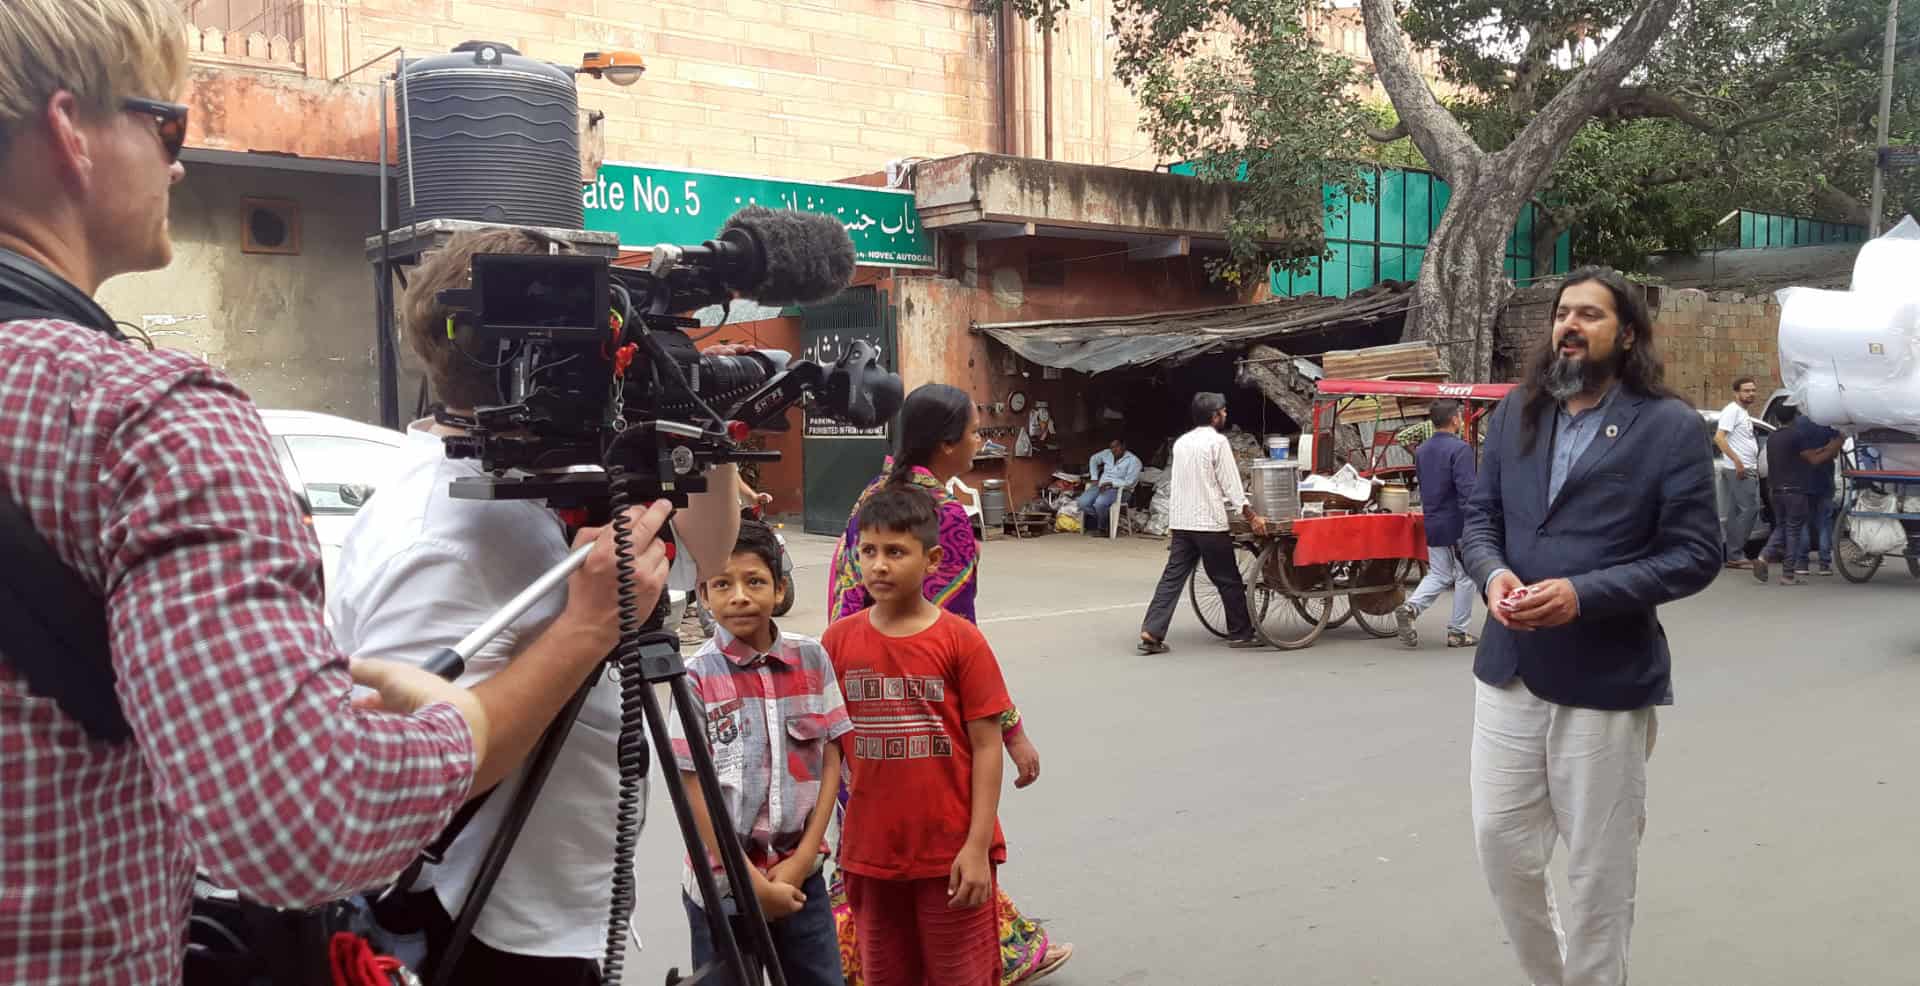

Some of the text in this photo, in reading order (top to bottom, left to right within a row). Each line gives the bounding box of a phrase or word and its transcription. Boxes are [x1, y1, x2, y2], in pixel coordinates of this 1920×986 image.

[583, 174, 625, 211] ate
[880, 201, 916, 243] باب
[754, 387, 784, 415] SHPE
